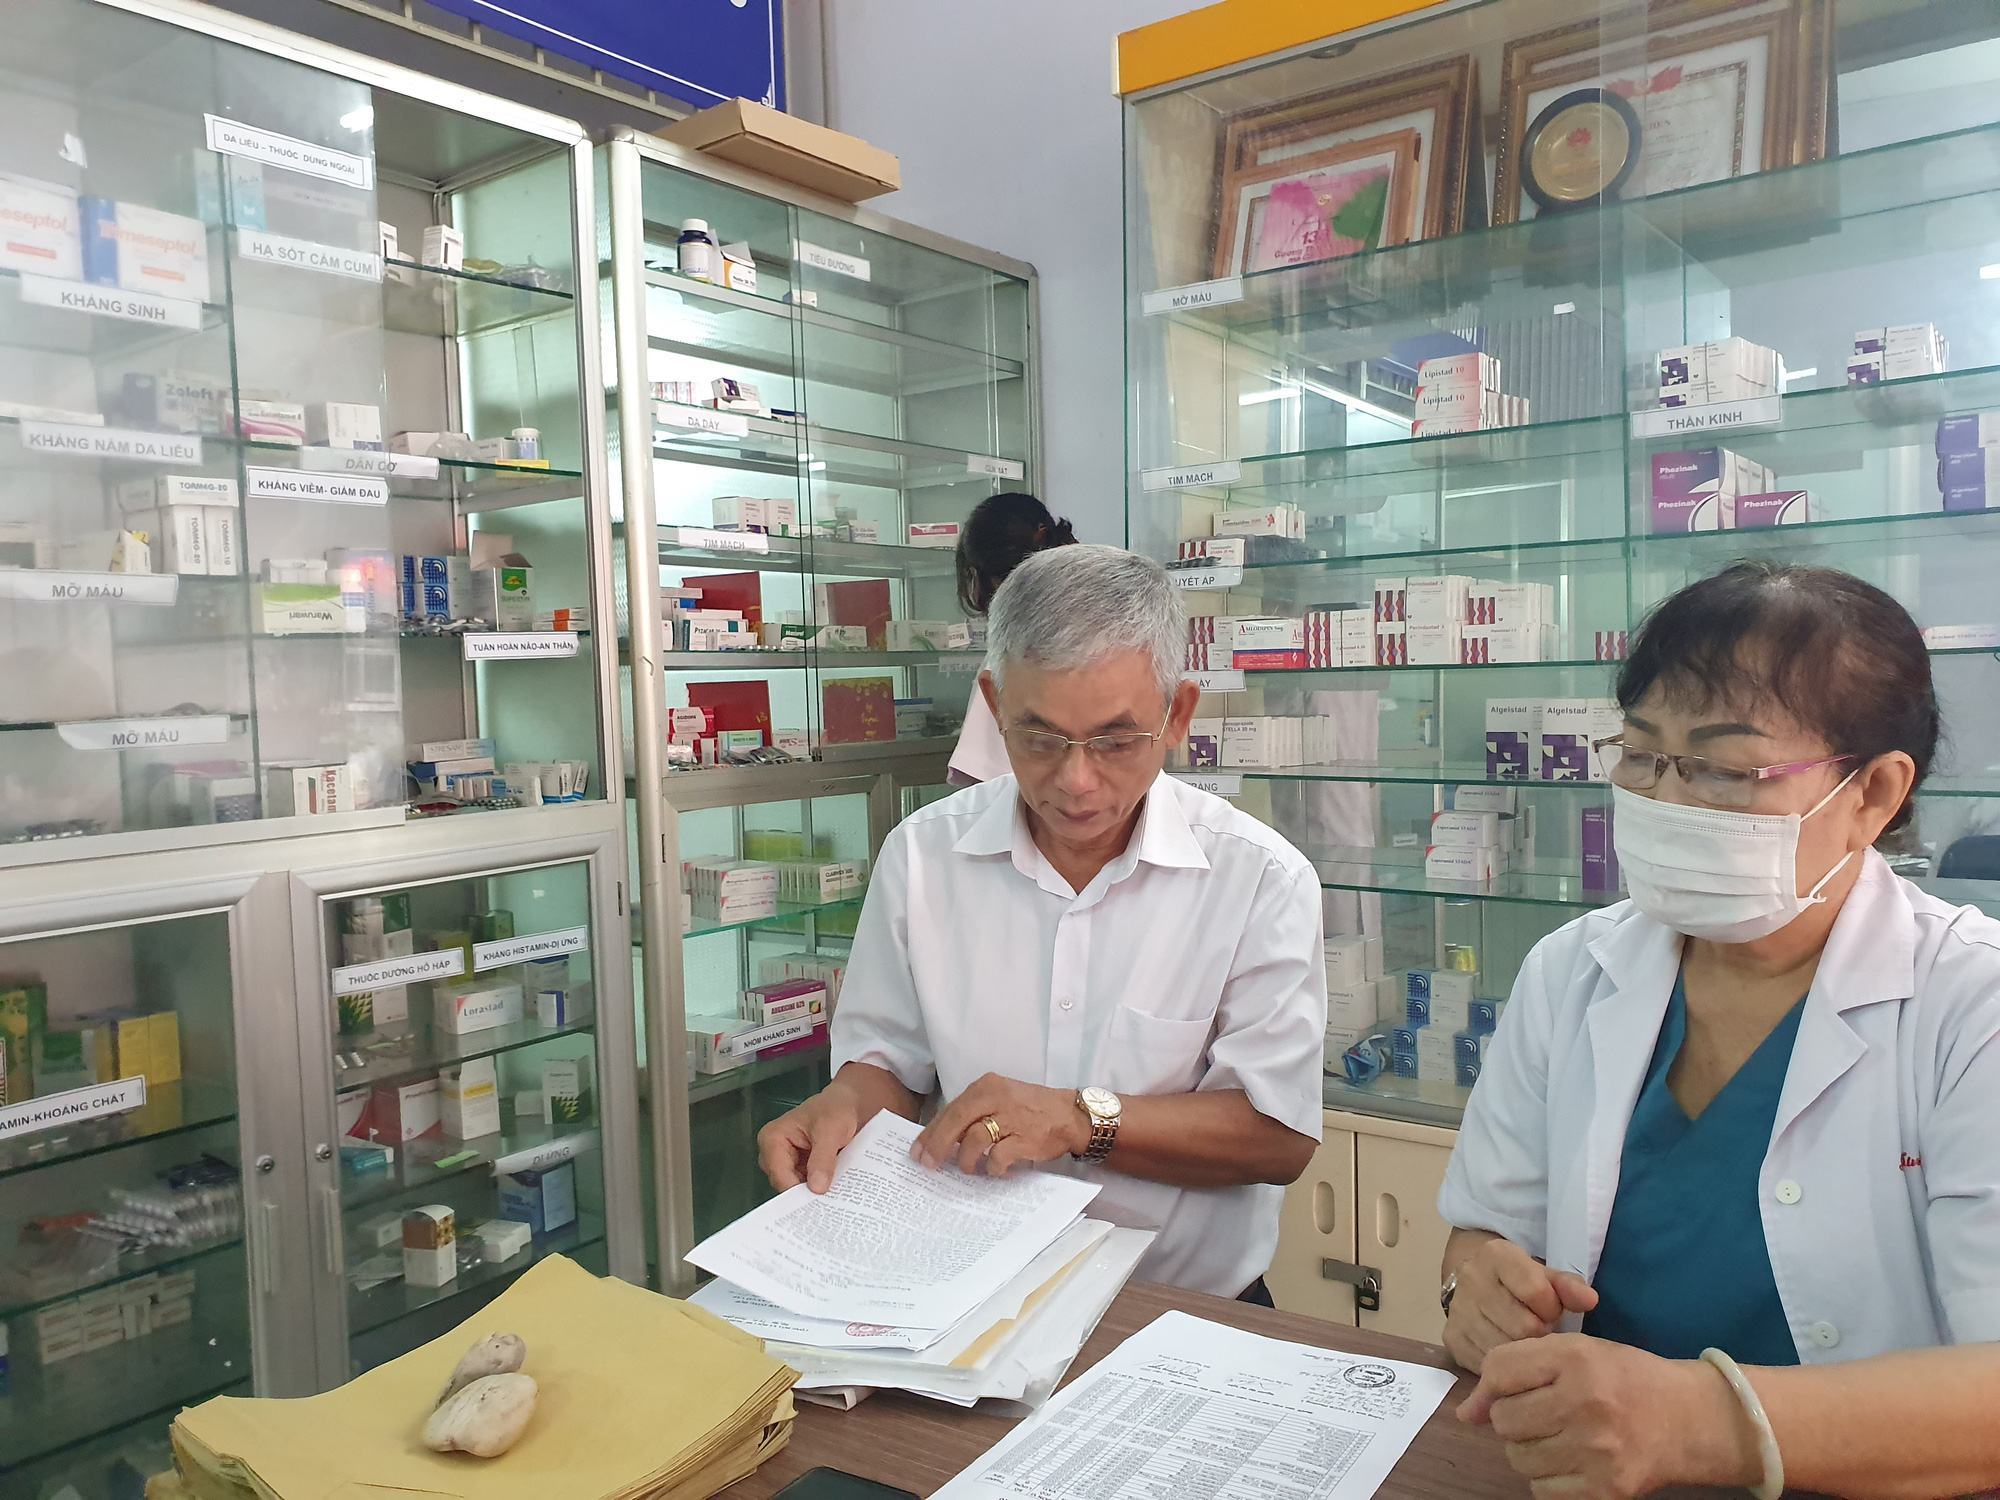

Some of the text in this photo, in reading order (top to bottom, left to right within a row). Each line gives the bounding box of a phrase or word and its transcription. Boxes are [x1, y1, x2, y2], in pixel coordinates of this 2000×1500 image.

[223, 133, 236, 144] DA
[0, 207, 67, 230] eseptol
[61, 291, 166, 320] KHÁNG SINH
[1424, 366, 1465, 379] Lipistad 10
[1423, 394, 1453, 406] Lipistad
[1709, 411, 1743, 427] KINH
[135, 443, 157, 455] DA
[180, 481, 228, 491] TORMEG-20
[1167, 475, 1184, 486] TIM
[258, 480, 297, 492] KHÁNG
[359, 488, 381, 499] ĐAU
[191, 516, 201, 564] TORMEG-20
[221, 519, 231, 566] TORMEG-10
[703, 538, 718, 549] TIM
[1175, 575, 1215, 587] UYẾT ÁP
[1199, 678, 1212, 688] ÀY
[483, 948, 511, 962] KHÁNG
[463, 1000, 505, 1017] Lorastad
[786, 1026, 801, 1036] SINH
[0, 1102, 89, 1131] AMIN-KHOÁNG
